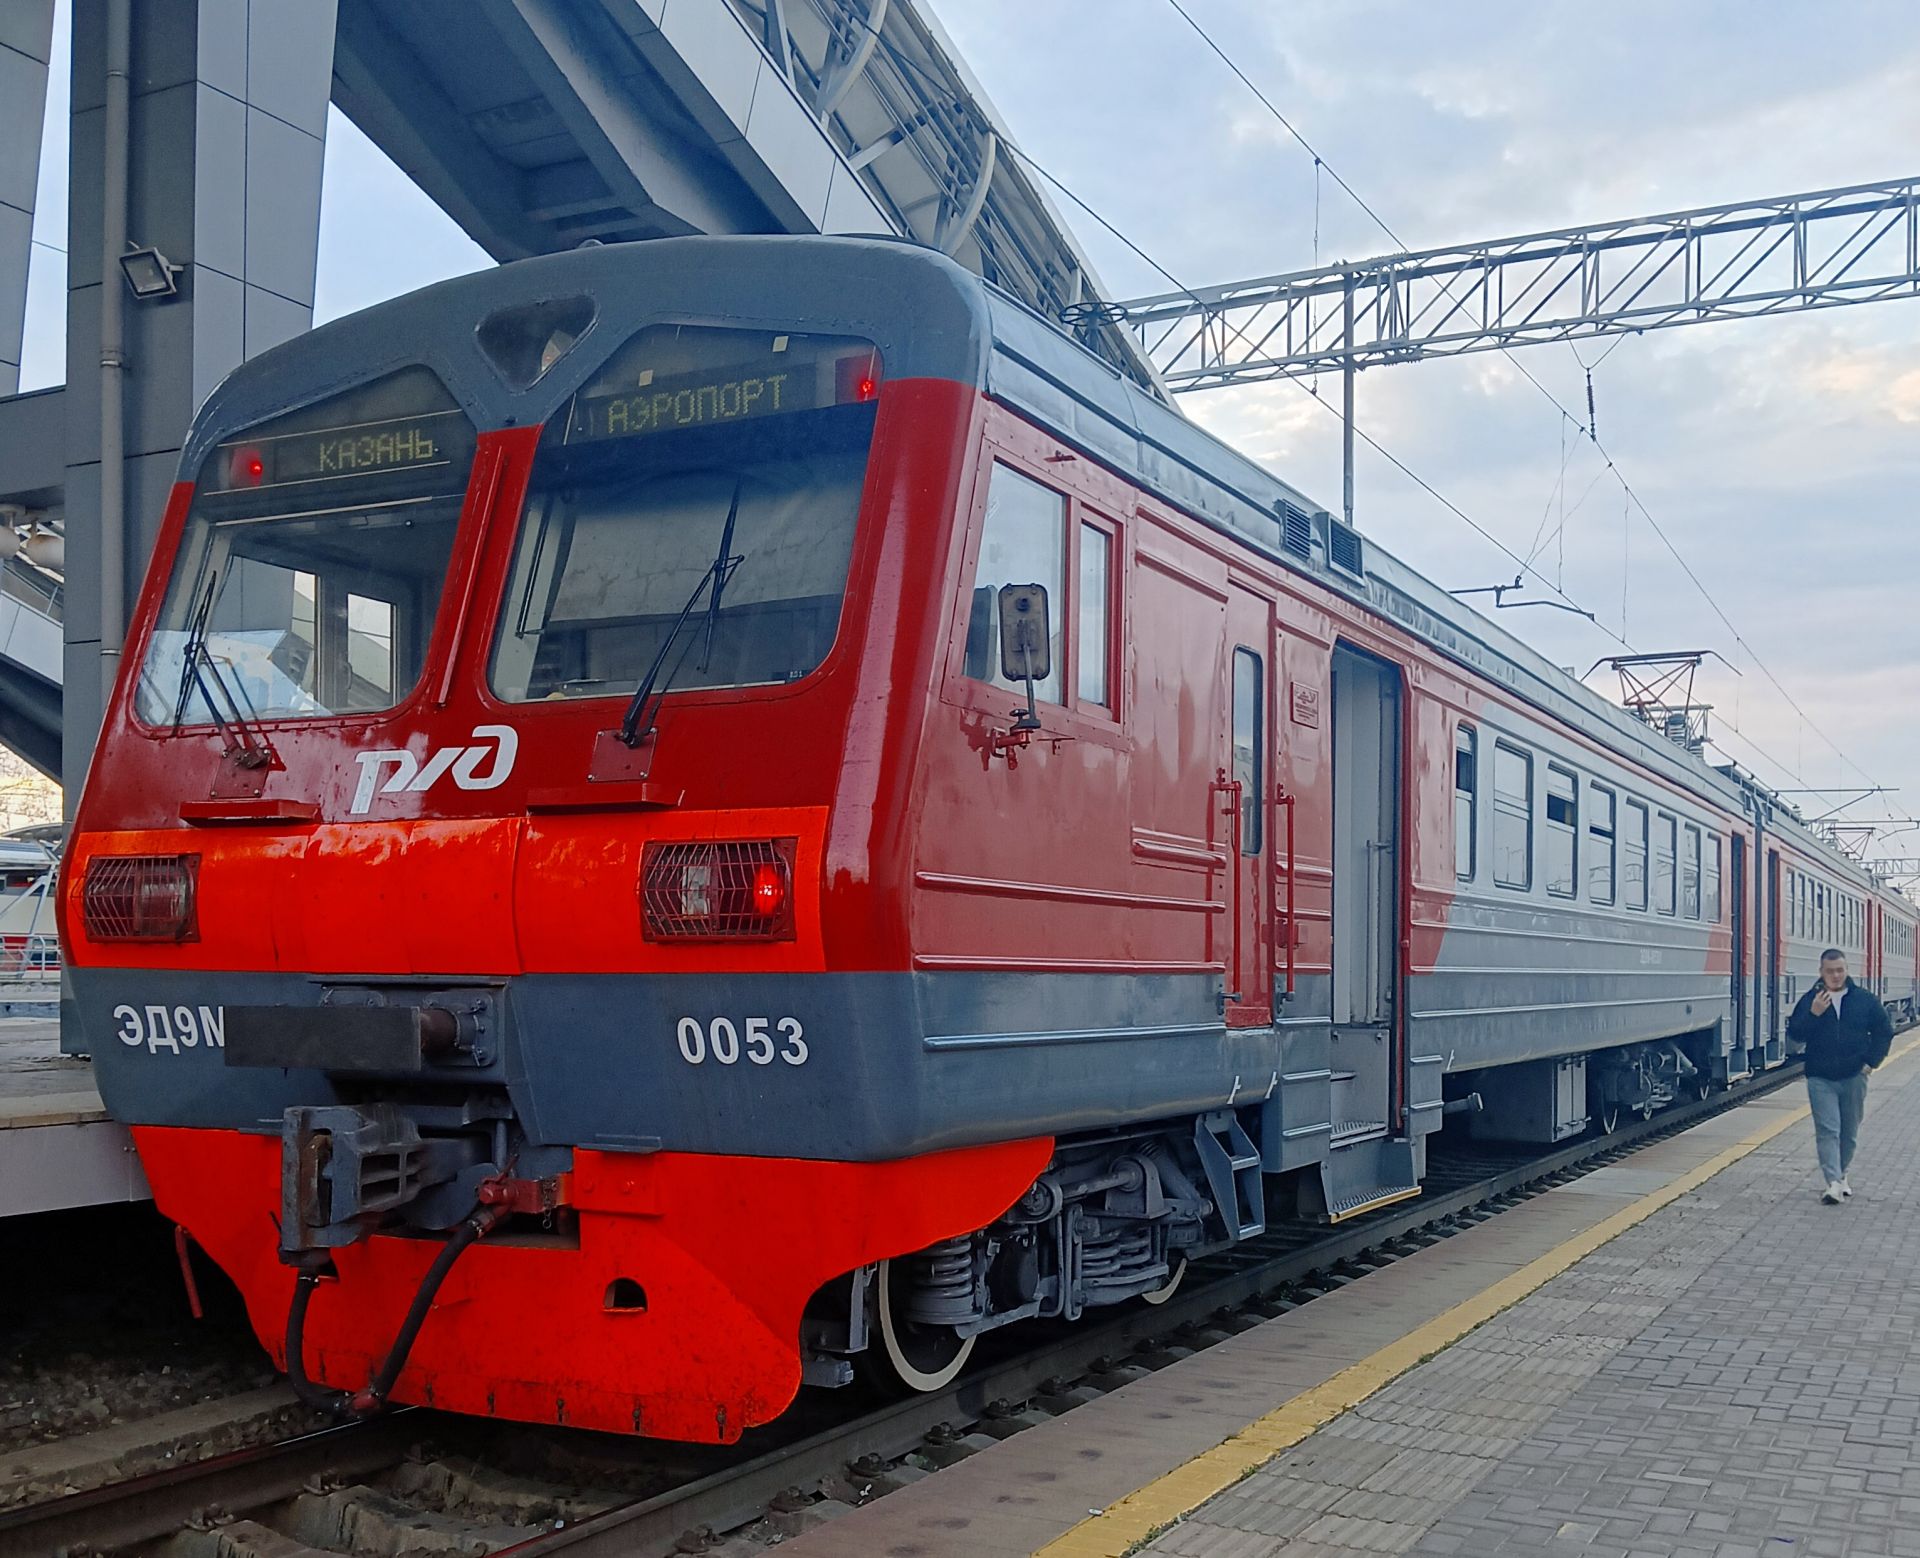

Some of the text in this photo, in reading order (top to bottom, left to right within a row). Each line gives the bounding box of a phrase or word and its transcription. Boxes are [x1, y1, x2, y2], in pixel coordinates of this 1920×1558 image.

[608, 374, 787, 434] АЭРОПОРТ
[320, 429, 433, 472] КАЗАНЬ
[677, 1016, 809, 1065] 0053
